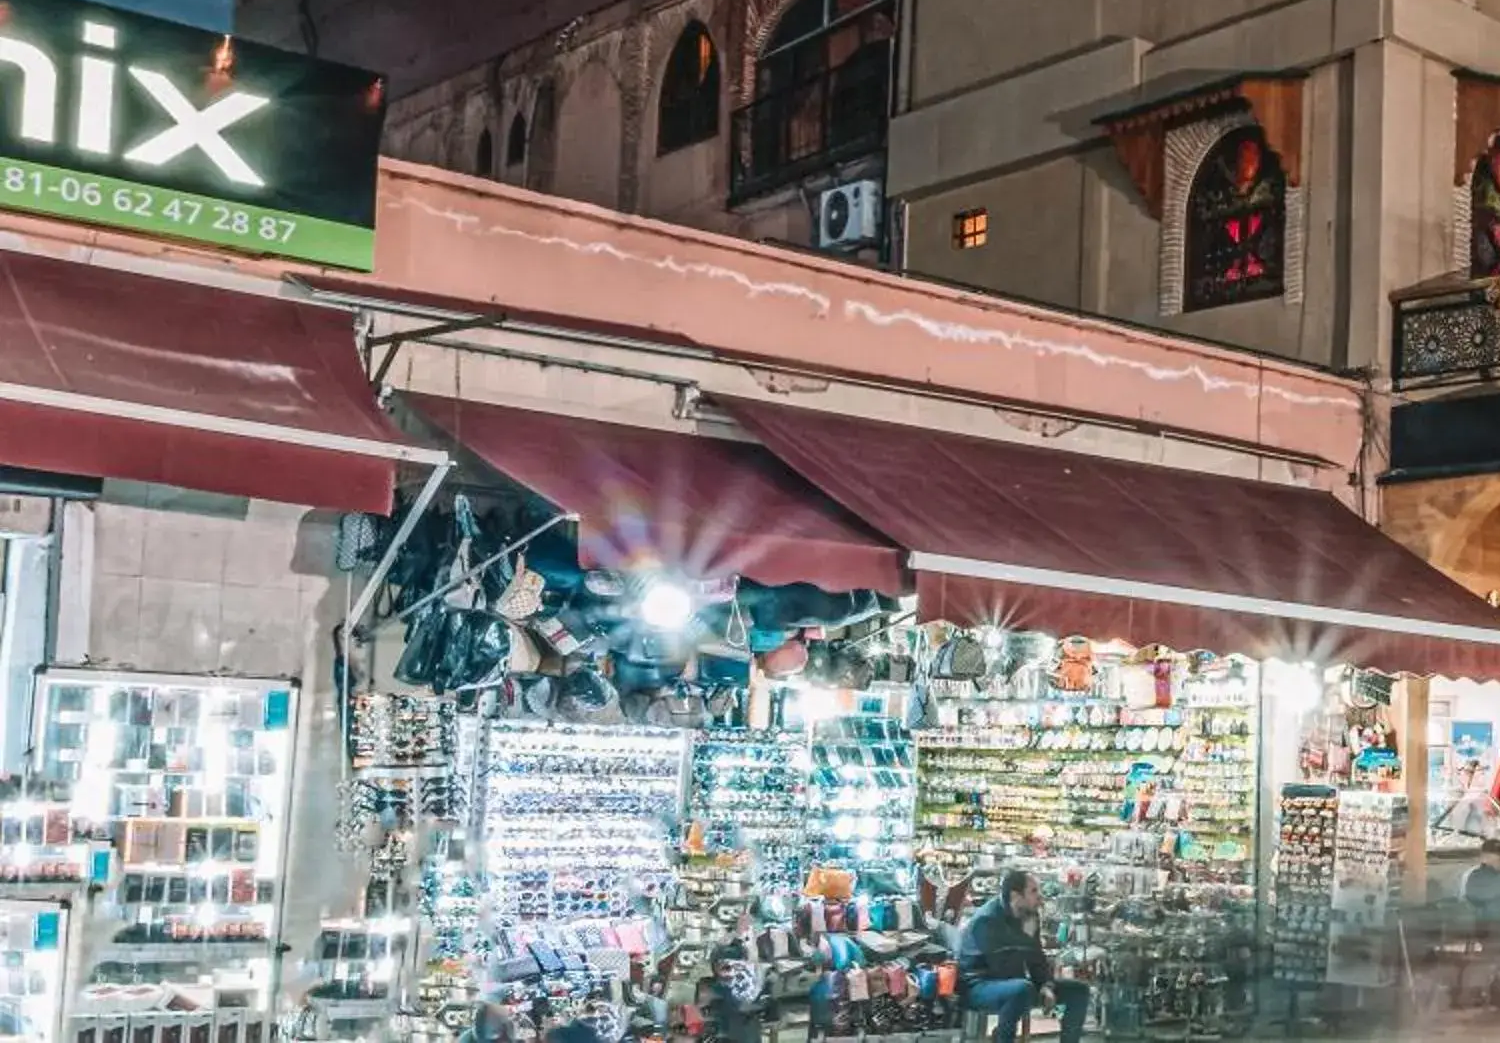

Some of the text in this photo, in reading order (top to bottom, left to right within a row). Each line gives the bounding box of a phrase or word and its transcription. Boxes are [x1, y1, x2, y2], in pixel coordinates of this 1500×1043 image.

[4, 167, 297, 245] 81-06 62 47 28 87
